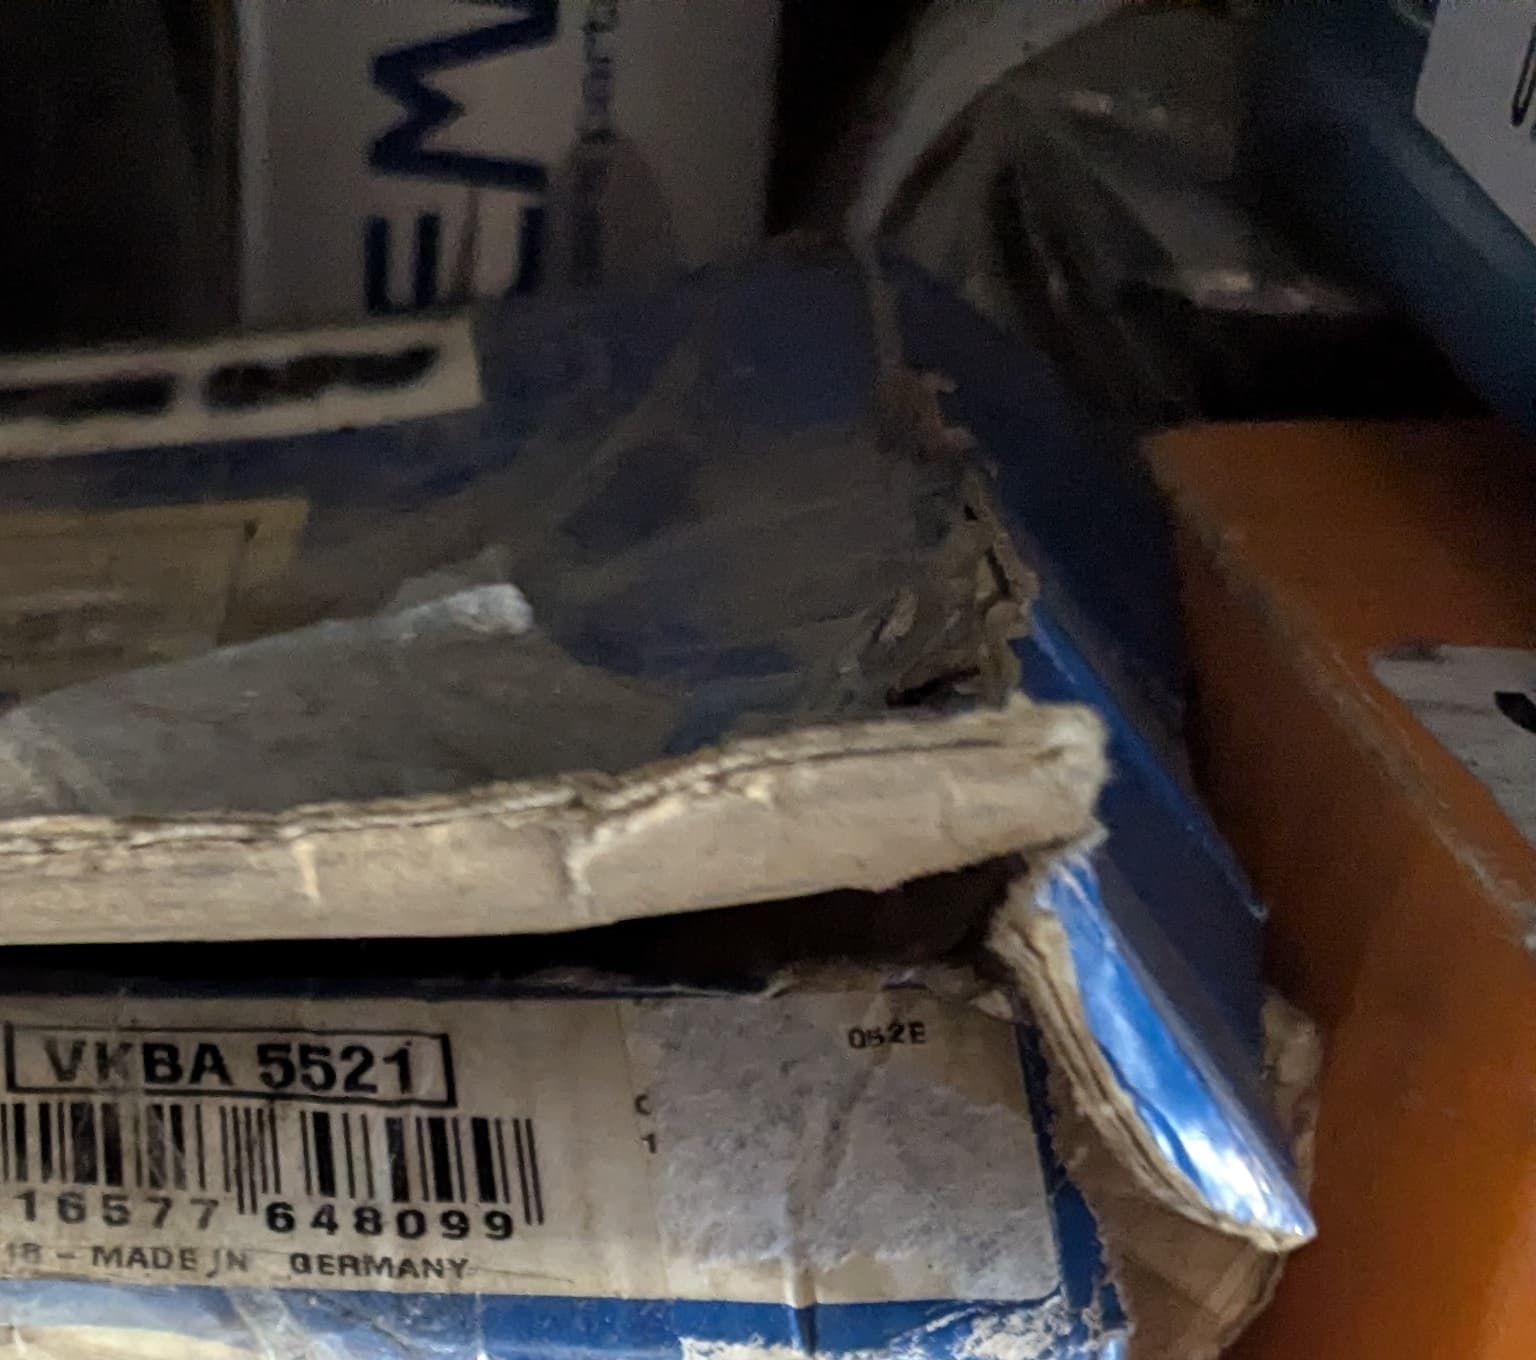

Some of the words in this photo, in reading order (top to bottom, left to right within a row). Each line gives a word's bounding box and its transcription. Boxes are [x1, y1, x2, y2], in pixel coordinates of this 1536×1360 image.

[41, 1034, 235, 1088] VKBA
[256, 1040, 416, 1097] 5521
[265, 1204, 517, 1241] 648099
[91, 1244, 199, 1272] MADE
[205, 1247, 248, 1278] IN
[289, 1252, 471, 1280] GERMANY
